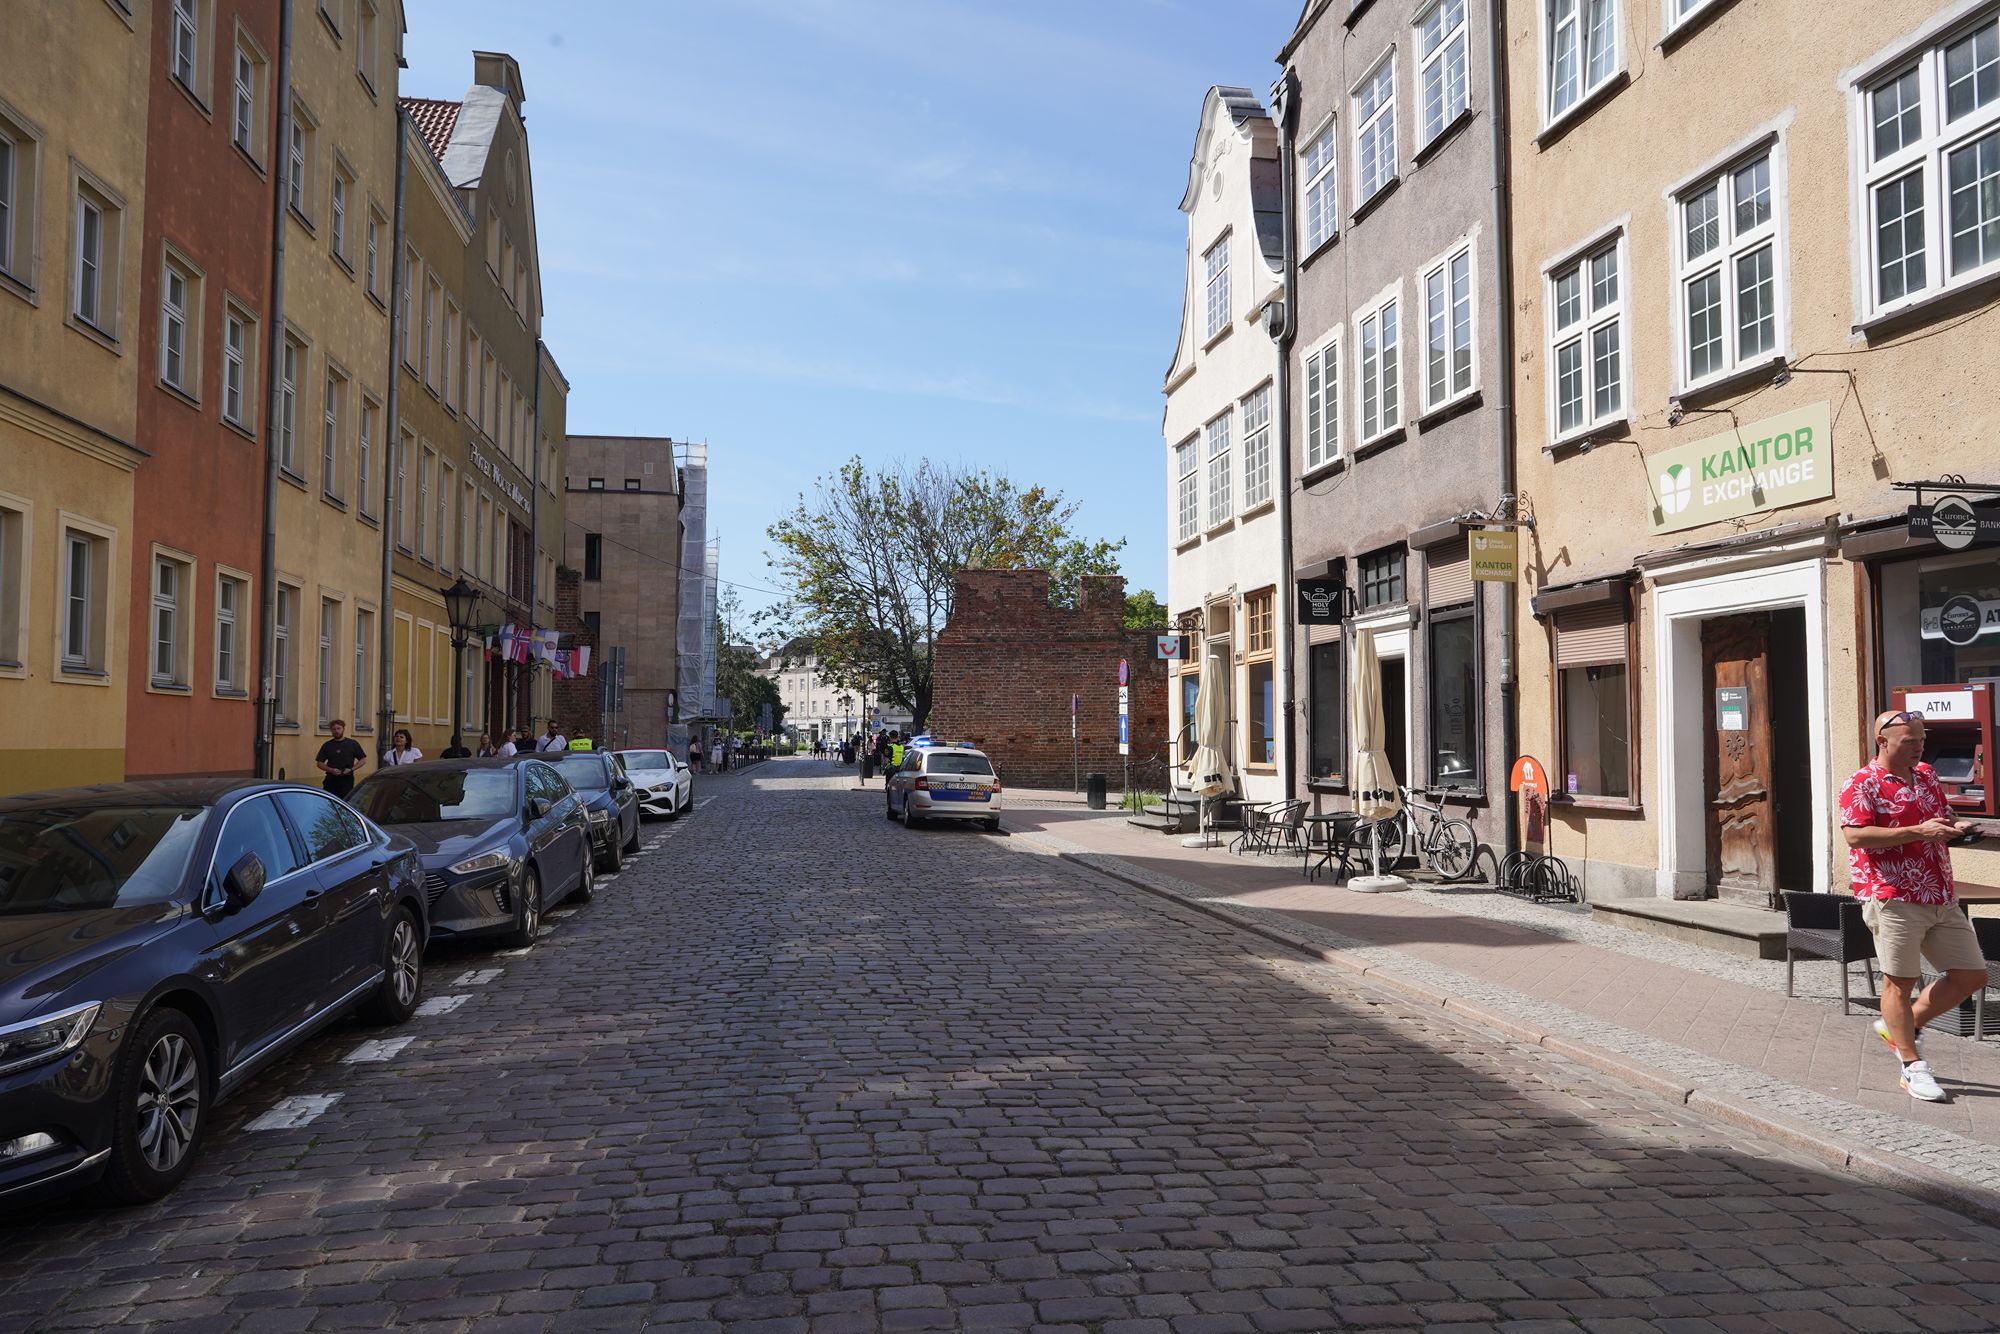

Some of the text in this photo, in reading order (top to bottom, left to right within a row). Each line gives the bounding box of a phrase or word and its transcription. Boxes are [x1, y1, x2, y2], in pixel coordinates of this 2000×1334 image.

[1701, 427, 1813, 481] KANTOR
[1702, 459, 1814, 506] EXCHANGE
[1911, 517, 1929, 526] ATM
[1475, 561, 1512, 570] KANTOR
[1475, 569, 1512, 577] EXCHANGE
[1926, 701, 1952, 712] ATM
